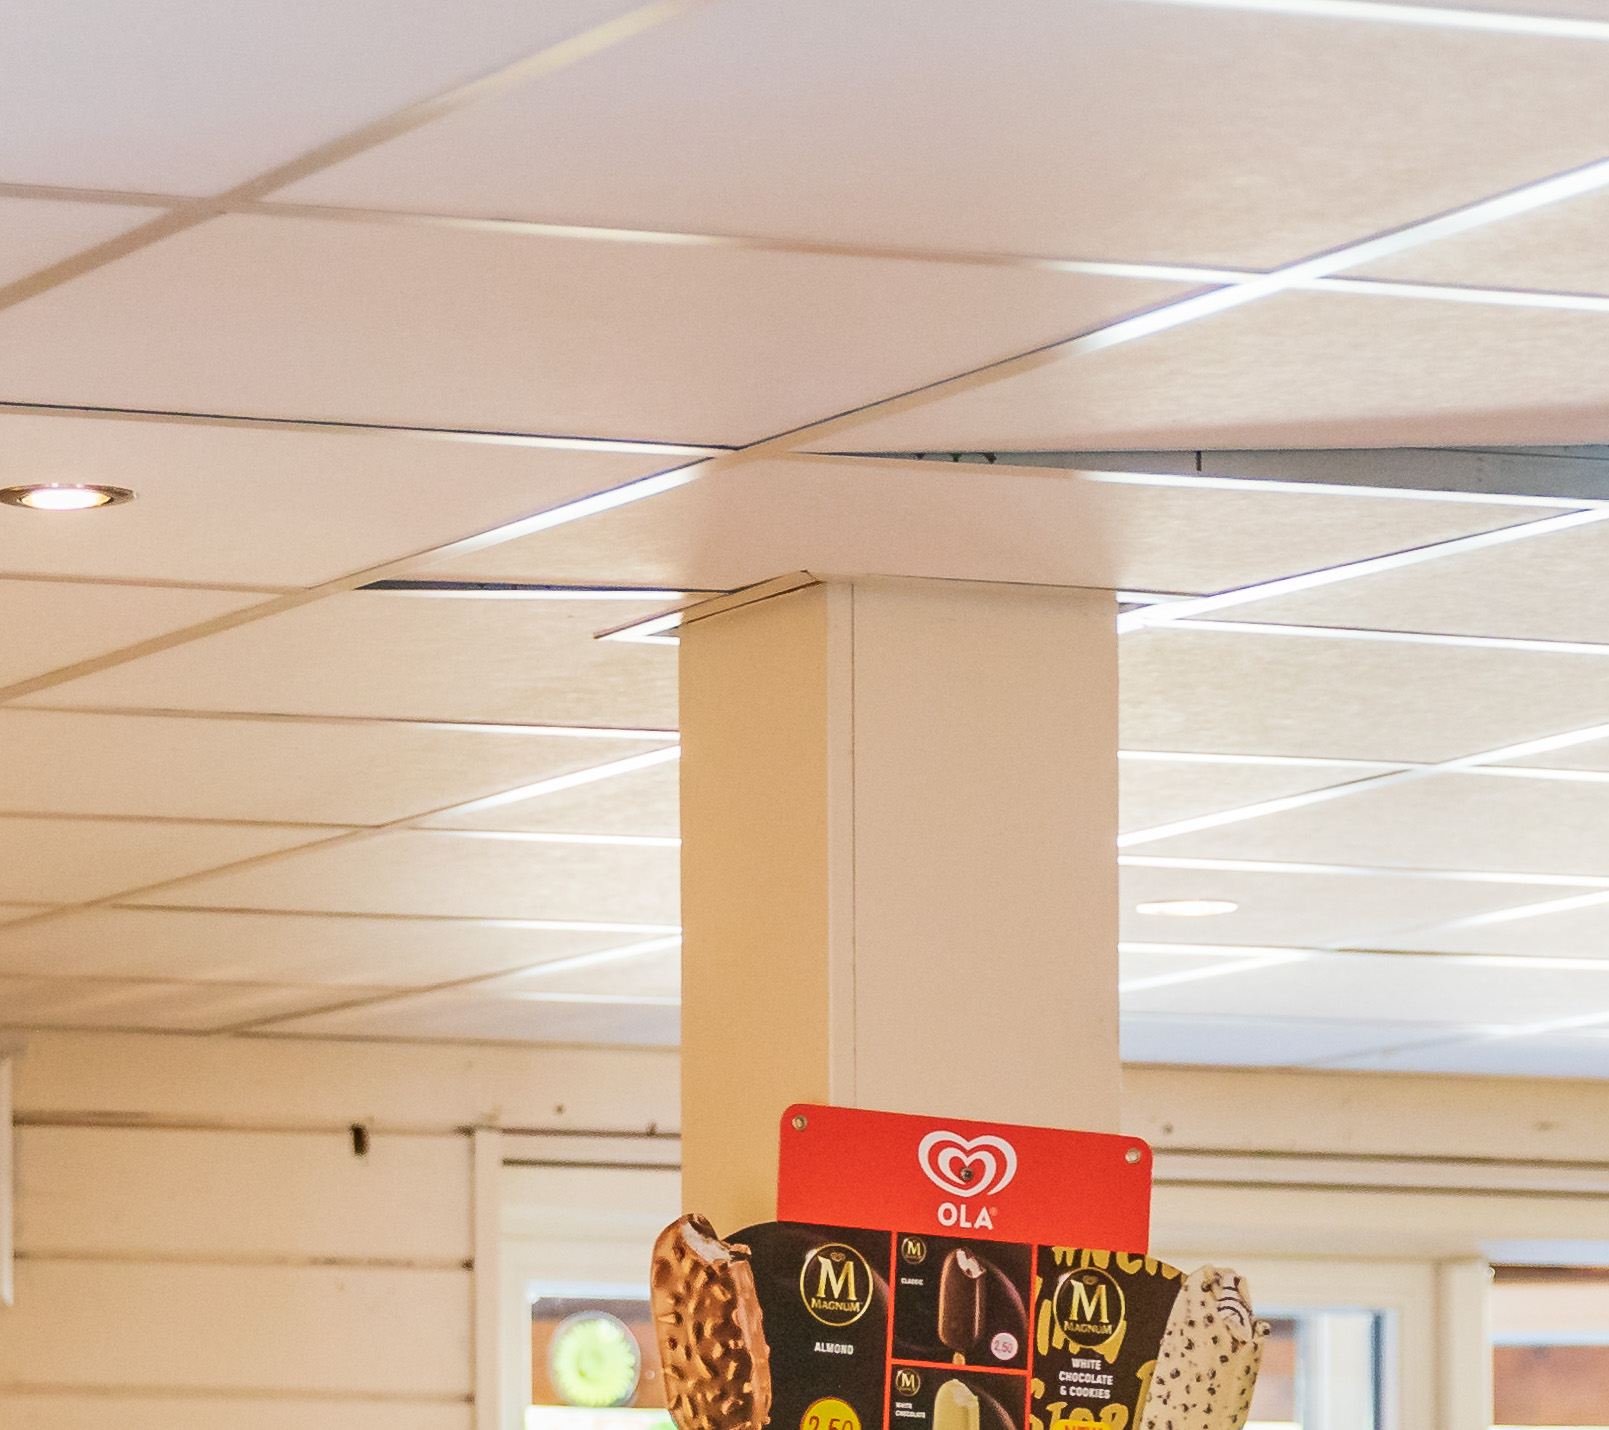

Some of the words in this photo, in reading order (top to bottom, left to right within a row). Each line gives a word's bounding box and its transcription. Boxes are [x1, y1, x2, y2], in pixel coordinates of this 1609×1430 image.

[811, 1298, 863, 1313] MAGNUM
[1063, 1320, 1113, 1336] MAGNUM
[814, 1341, 854, 1355] ALMOND
[1071, 1357, 1102, 1371] WHITE
[1058, 1370, 1114, 1386] CHOCOLATE
[1068, 1386, 1111, 1399] COOKIES
